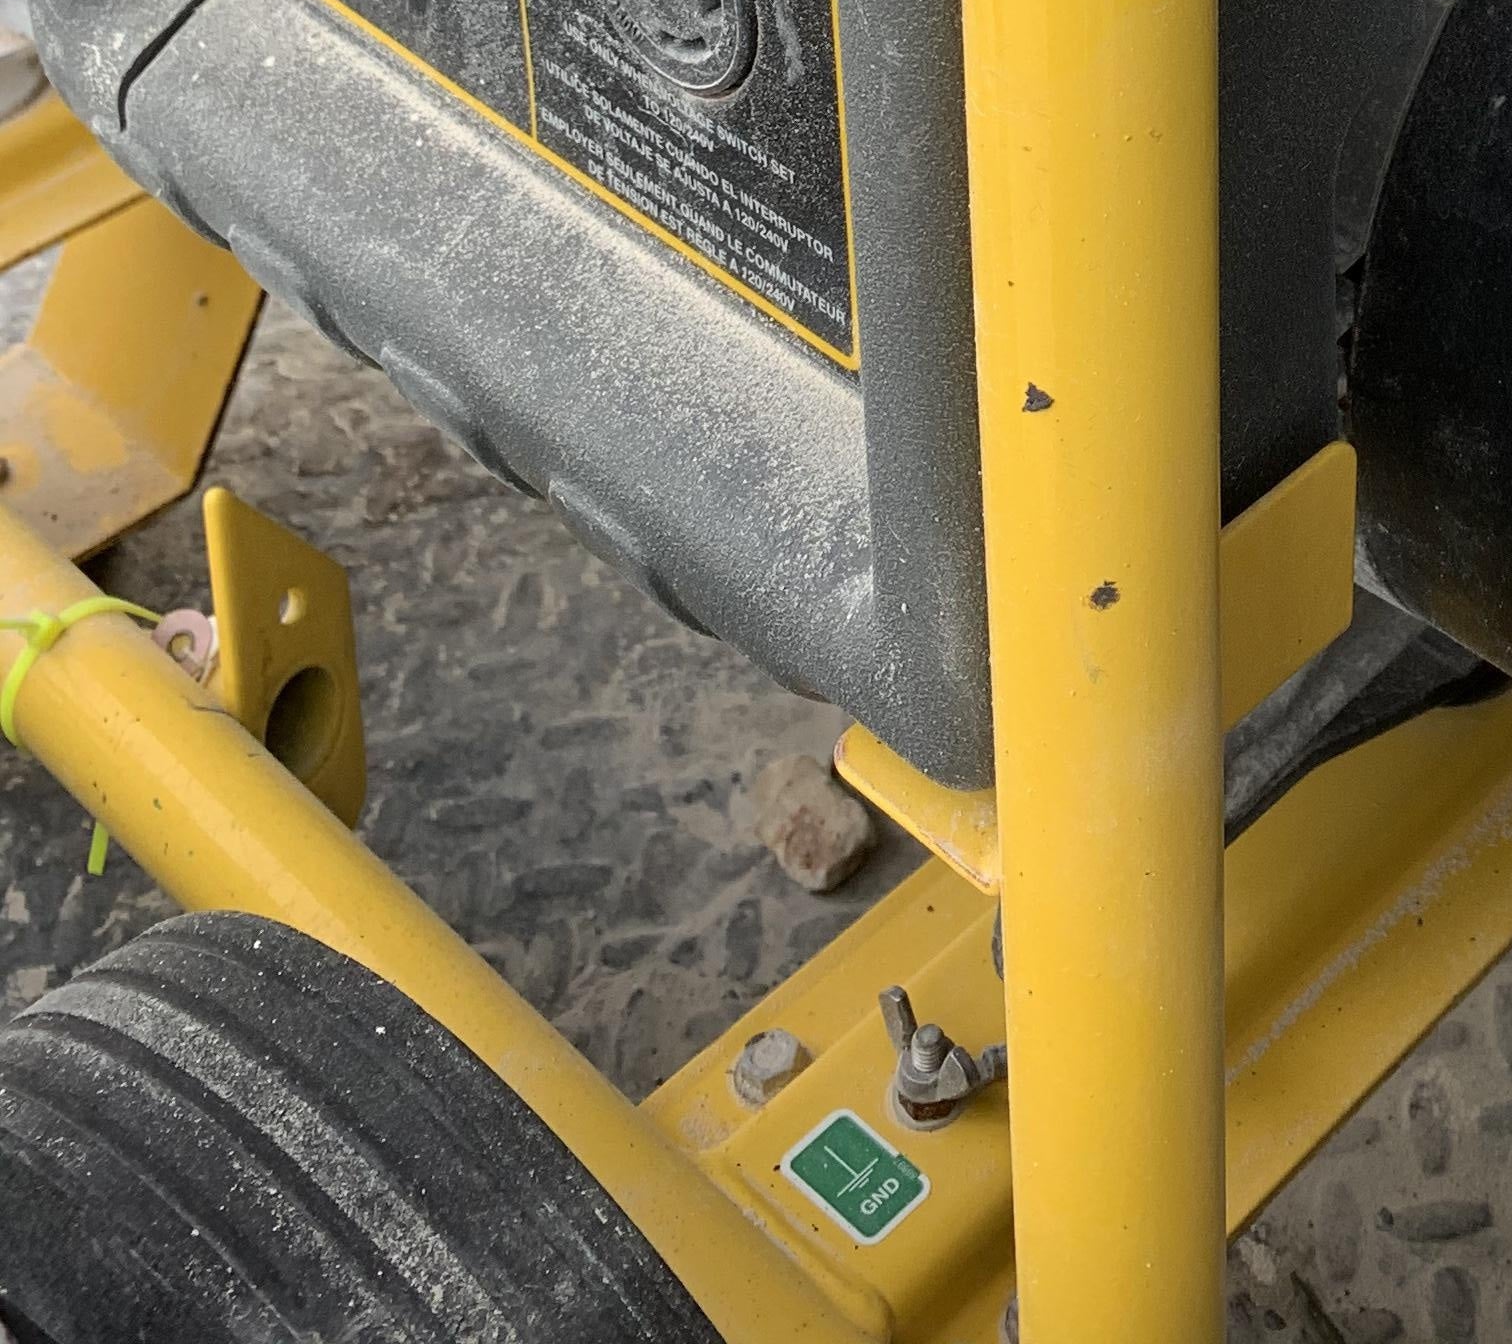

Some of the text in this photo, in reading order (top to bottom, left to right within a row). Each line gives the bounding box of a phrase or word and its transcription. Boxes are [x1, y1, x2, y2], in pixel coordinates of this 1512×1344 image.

[540, 59, 834, 263] UTILICE SOLAMENTE CUANDO EL INTERRUPTOR
[563, 20, 588, 47] USE
[589, 38, 619, 68] ONLY
[716, 122, 768, 168] SWITCH
[771, 159, 796, 184] SET
[642, 95, 660, 116] TO
[540, 107, 846, 326] EMPLOYER SEULEMENT QUAND LE COMMUTATEUR
[583, 105, 790, 254] DE VOLTAJE SE AJUSTA A 120/240V
[588, 159, 605, 183] DE
[606, 169, 659, 218] TENSION
[660, 209, 683, 235] EST
[730, 258, 740, 275] A
[741, 268, 796, 312] 120/240V
[859, 1176, 900, 1216] GND
